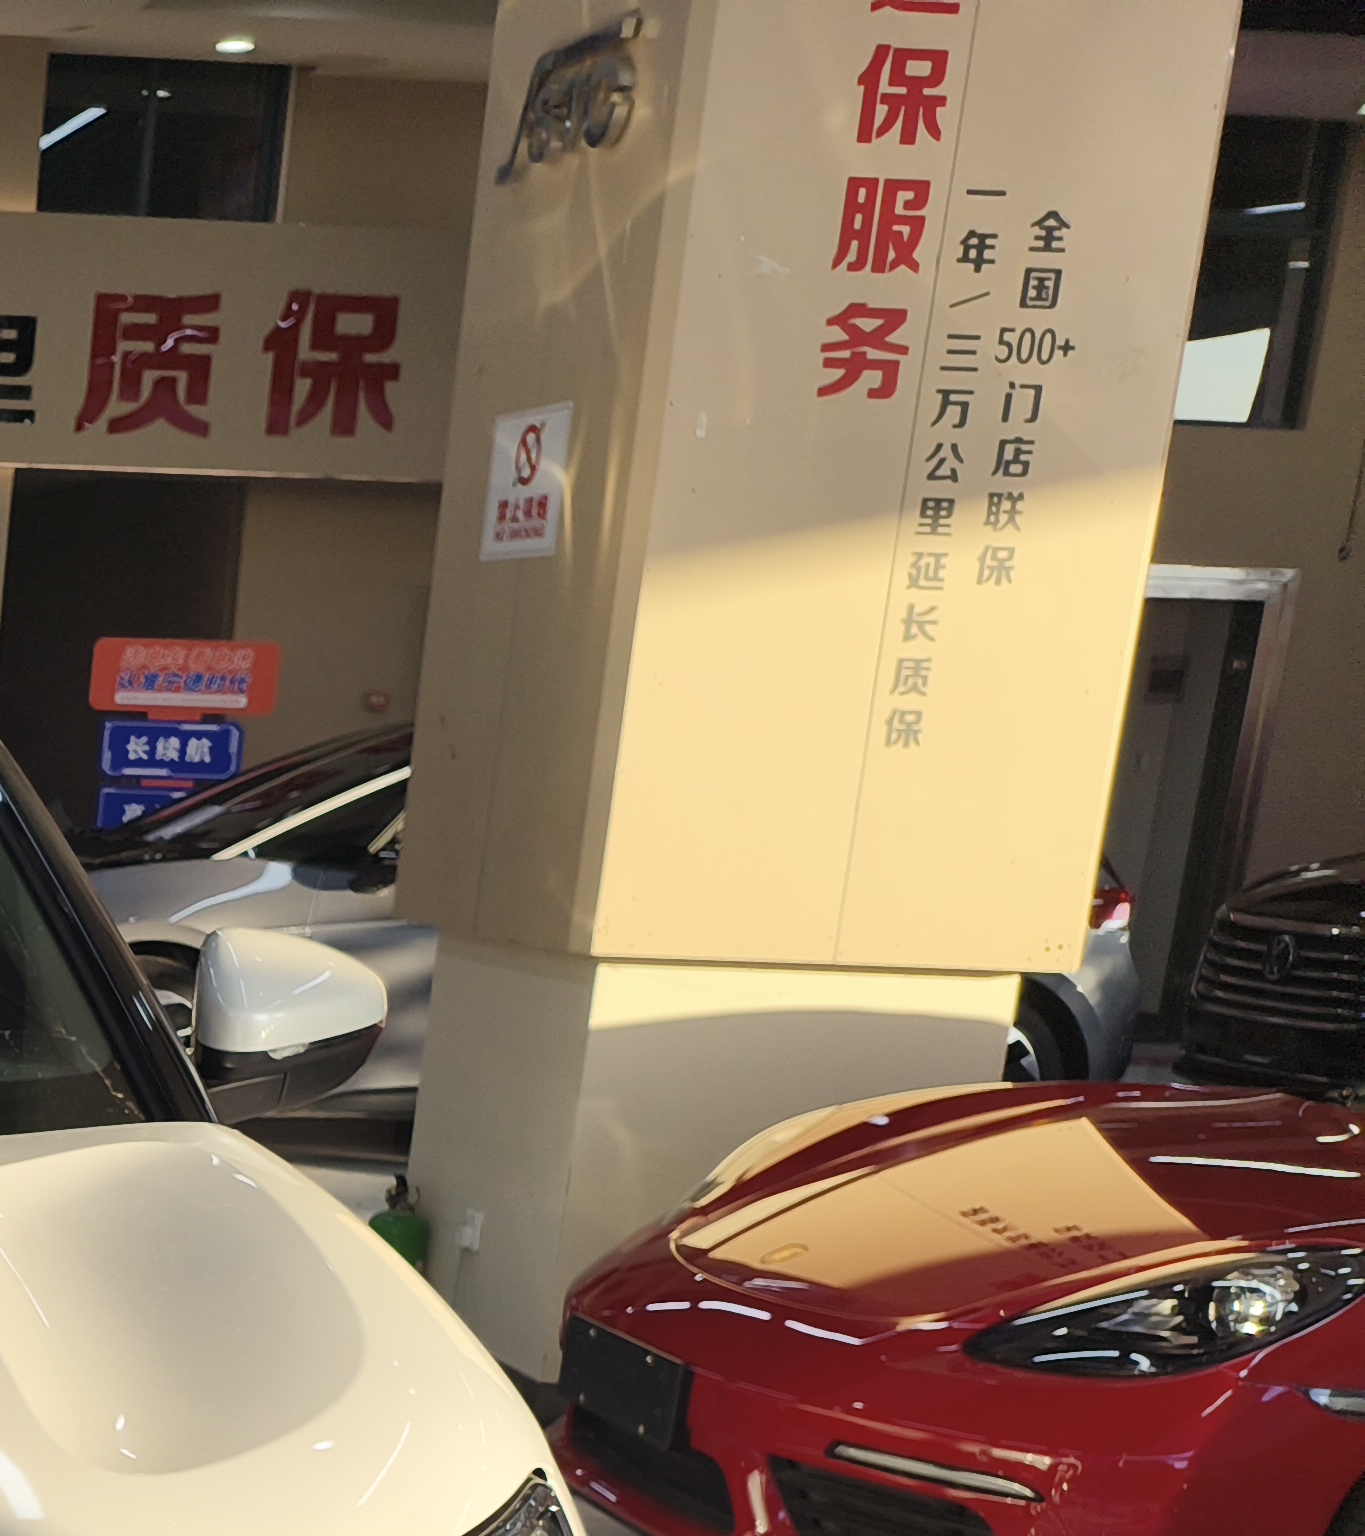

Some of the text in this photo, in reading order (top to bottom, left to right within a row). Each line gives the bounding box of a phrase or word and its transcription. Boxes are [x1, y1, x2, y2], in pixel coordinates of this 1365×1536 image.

[817, 0, 960, 399] 保服务
[975, 209, 1076, 586] 全国500+门店联保
[126, 735, 213, 763] 长续航
